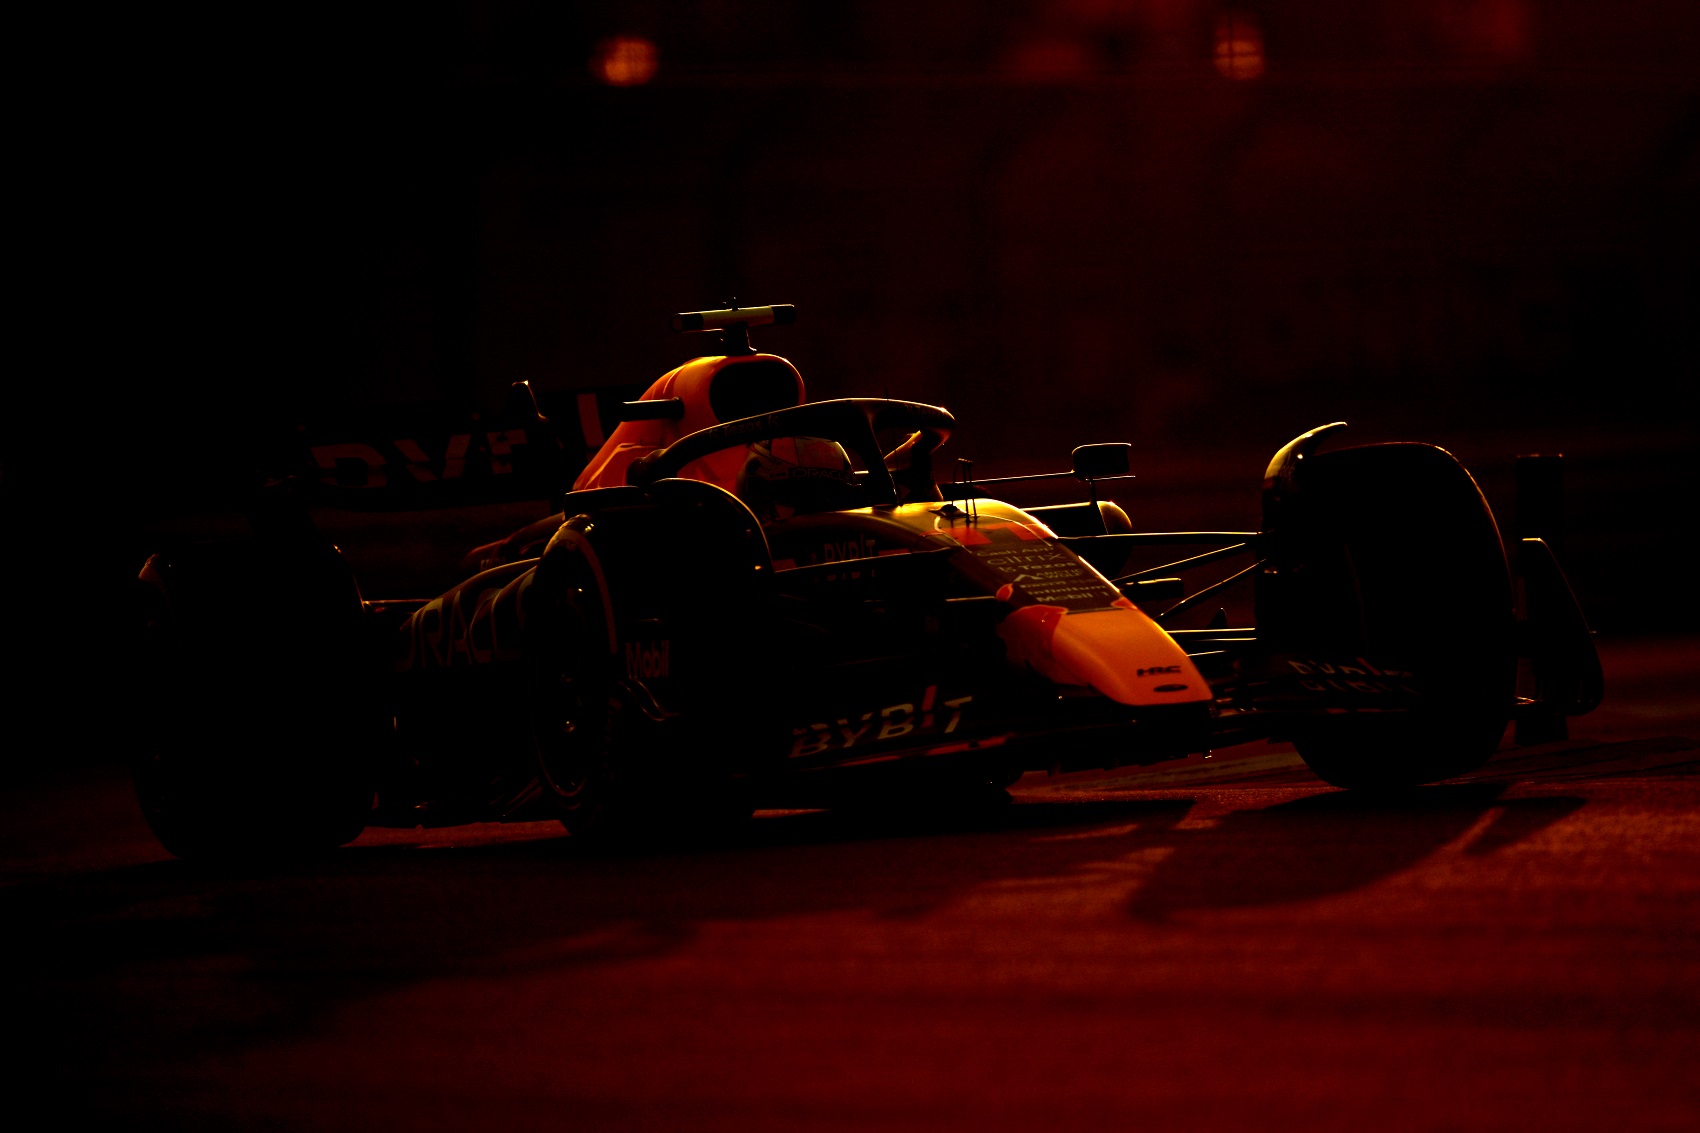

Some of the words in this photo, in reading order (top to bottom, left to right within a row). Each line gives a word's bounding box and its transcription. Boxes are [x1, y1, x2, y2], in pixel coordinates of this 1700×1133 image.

[1036, 592, 1093, 602] Mobil
[625, 639, 669, 679] Mobil
[787, 683, 974, 759] BYBIT
